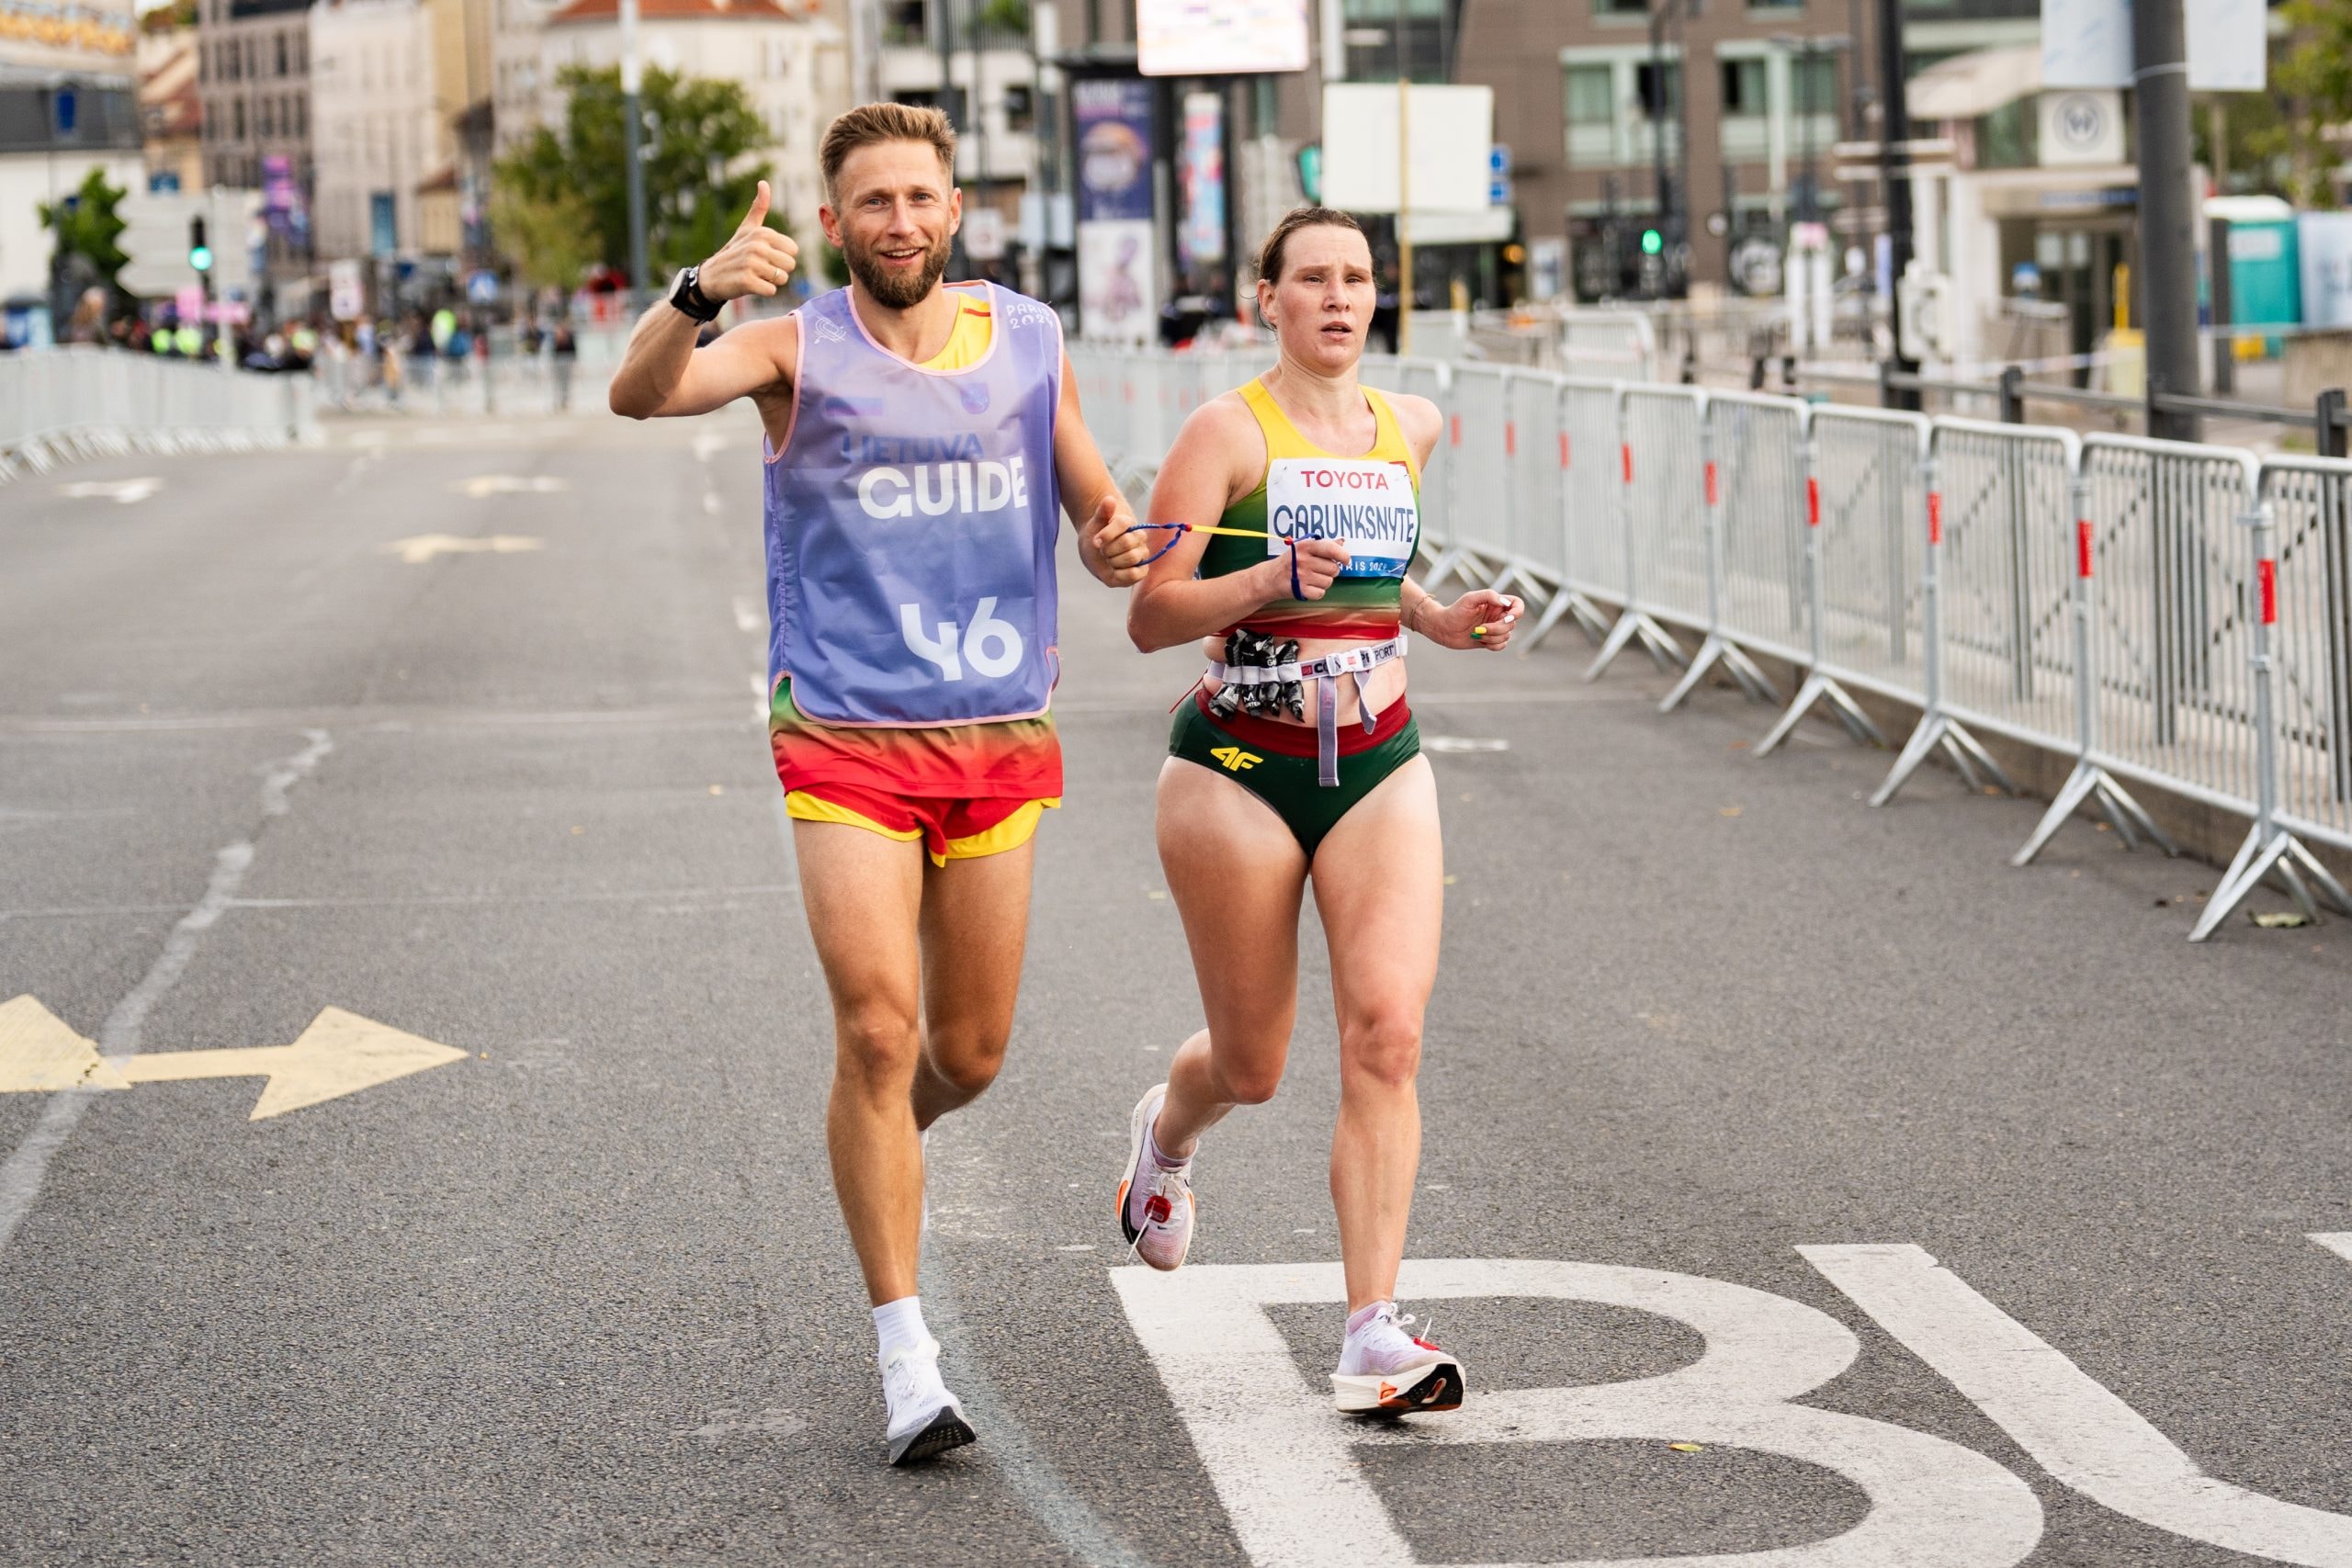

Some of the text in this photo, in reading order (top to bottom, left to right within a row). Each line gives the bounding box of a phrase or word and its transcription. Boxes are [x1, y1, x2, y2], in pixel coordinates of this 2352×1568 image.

[857, 456, 1029, 520] GUIDE
[1300, 469, 1390, 491] TOYOTA
[1272, 504, 1415, 543] GABUNKSNYTE
[1335, 558, 1366, 571] ARIS
[899, 596, 1023, 682] 46
[1210, 747, 1264, 772] 4F
